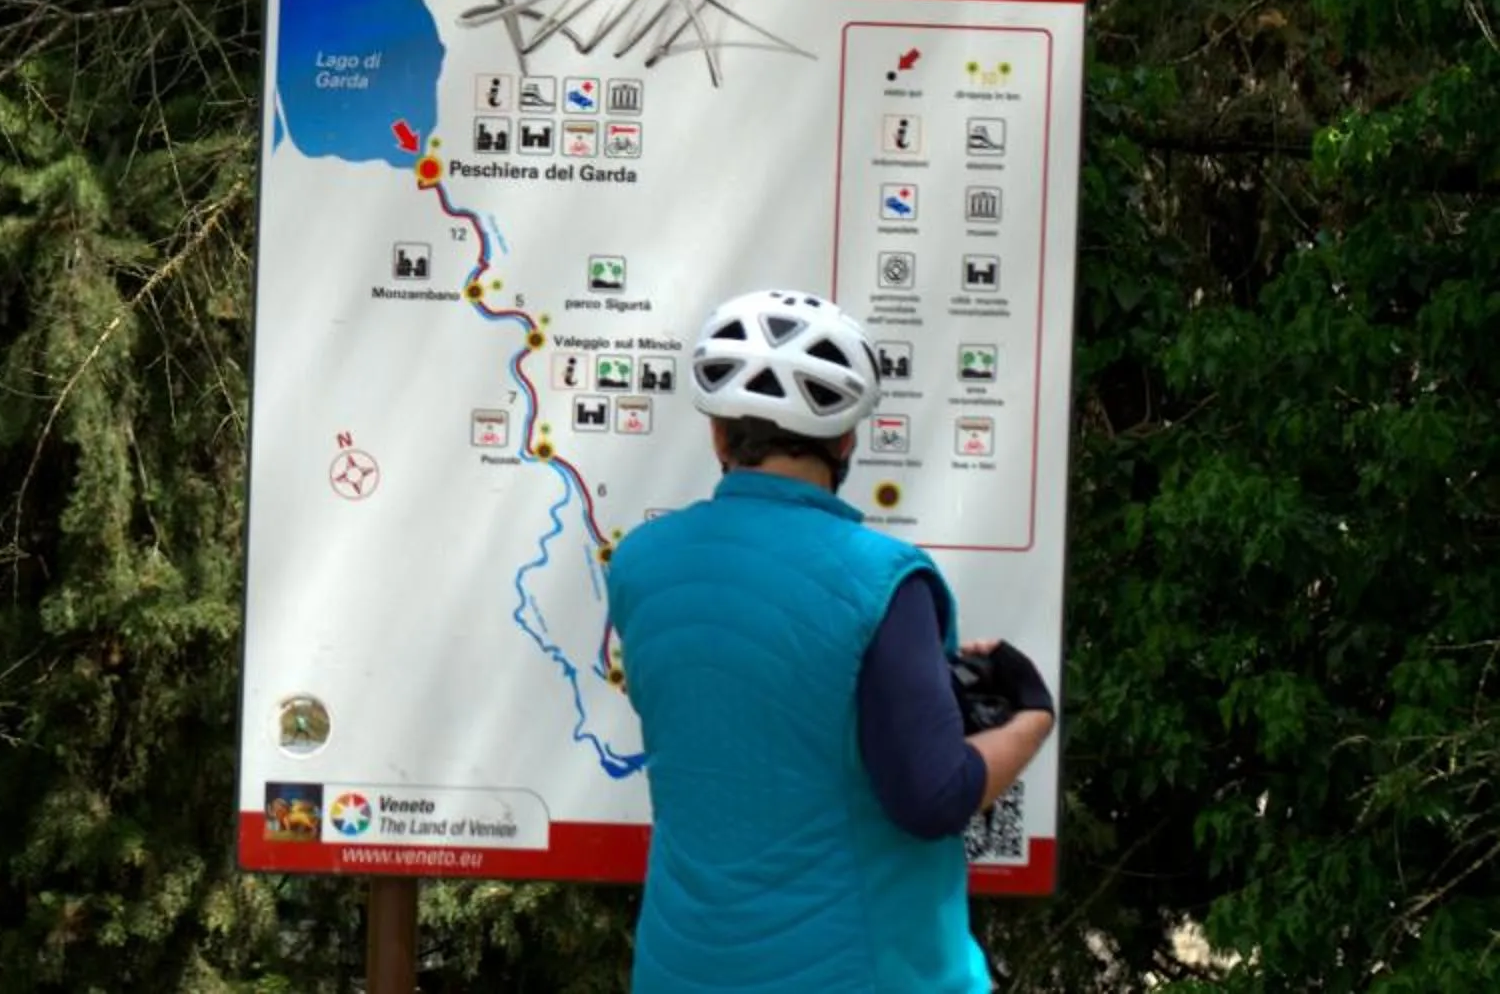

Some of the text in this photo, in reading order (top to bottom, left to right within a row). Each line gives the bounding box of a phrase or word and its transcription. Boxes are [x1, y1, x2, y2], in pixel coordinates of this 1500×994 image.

[316, 50, 383, 70] Lago di
[316, 71, 369, 89] Garda
[450, 160, 638, 184] Peschiera del Garda
[451, 227, 467, 241] 12
[372, 286, 460, 302] Monzambano
[554, 335, 682, 351] Valeggio sul Mincio
[379, 795, 435, 813] Veneto
[379, 818, 404, 835] The
[409, 820, 446, 836] Land
[450, 821, 465, 837] of
